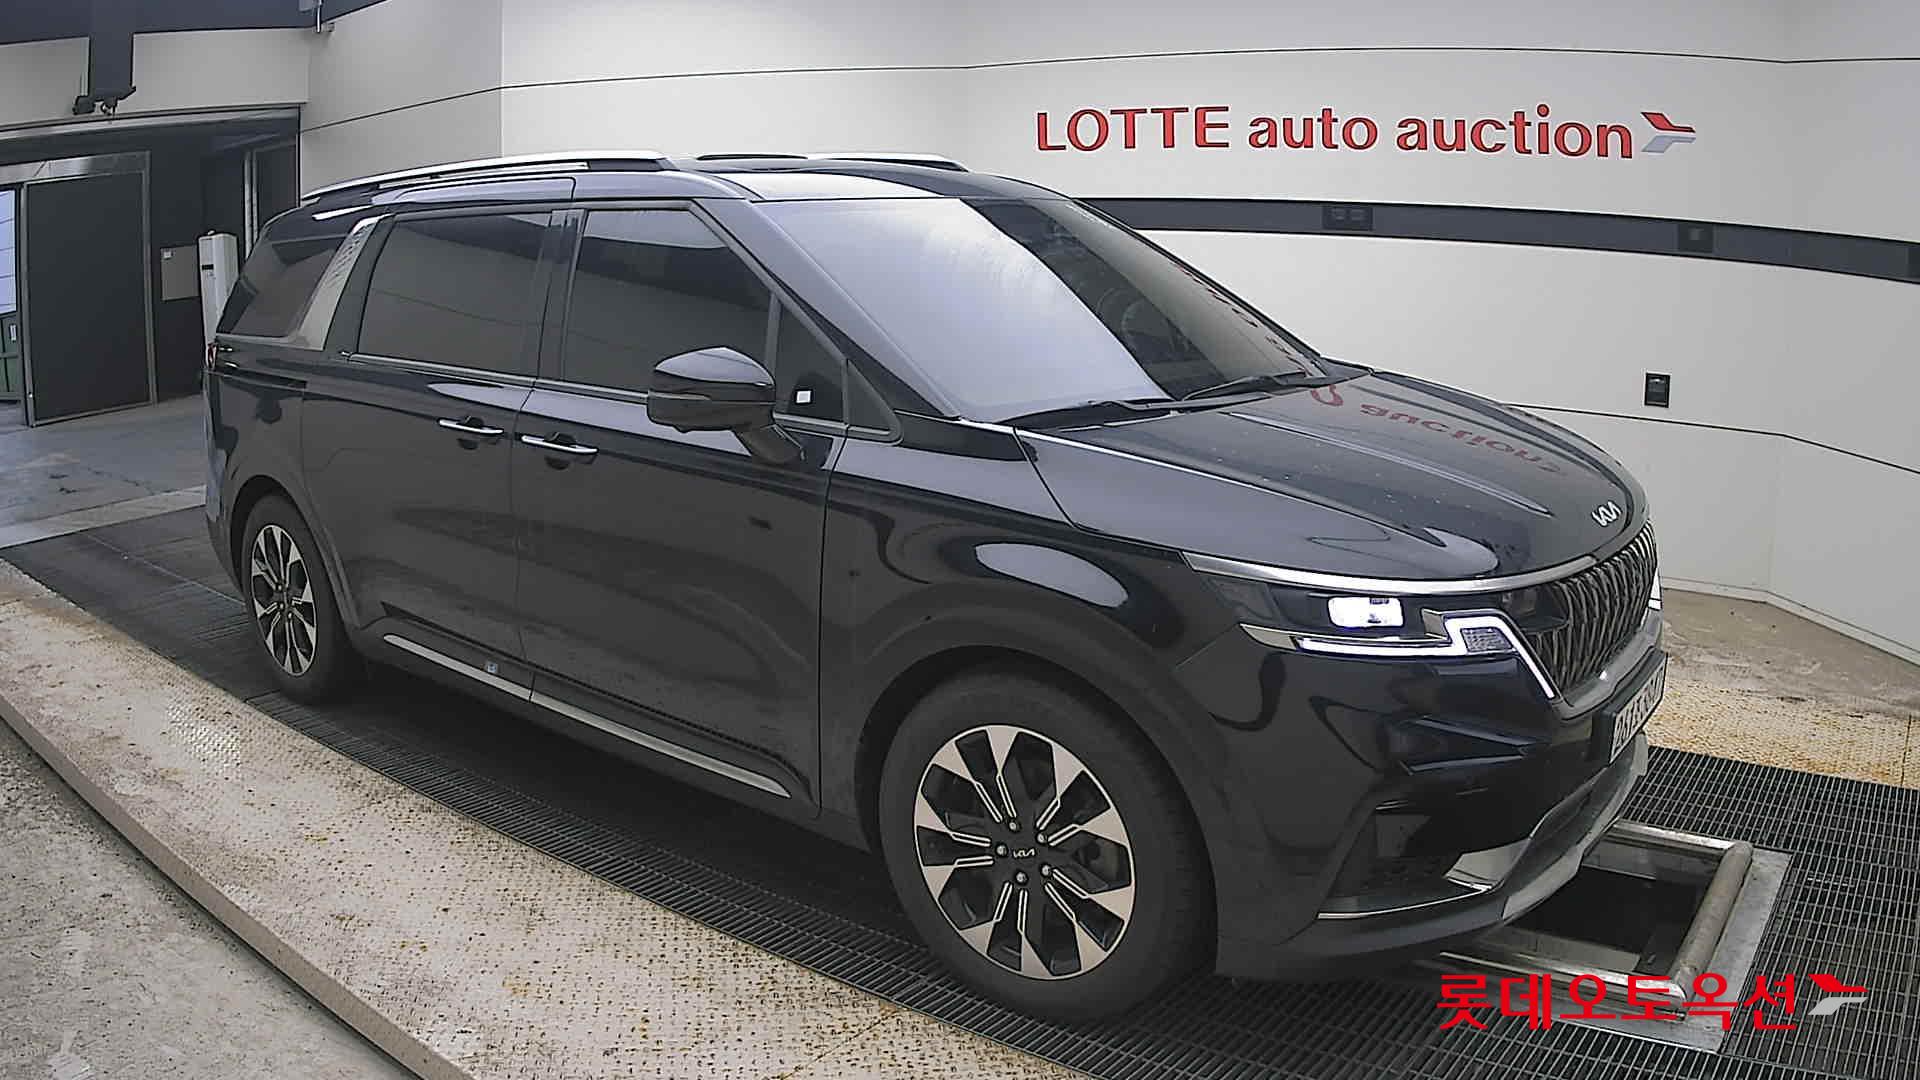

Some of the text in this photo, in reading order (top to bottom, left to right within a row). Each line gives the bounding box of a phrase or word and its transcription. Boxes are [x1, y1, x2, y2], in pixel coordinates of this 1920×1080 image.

[1036, 103, 1634, 159] LOTTE auto auction
